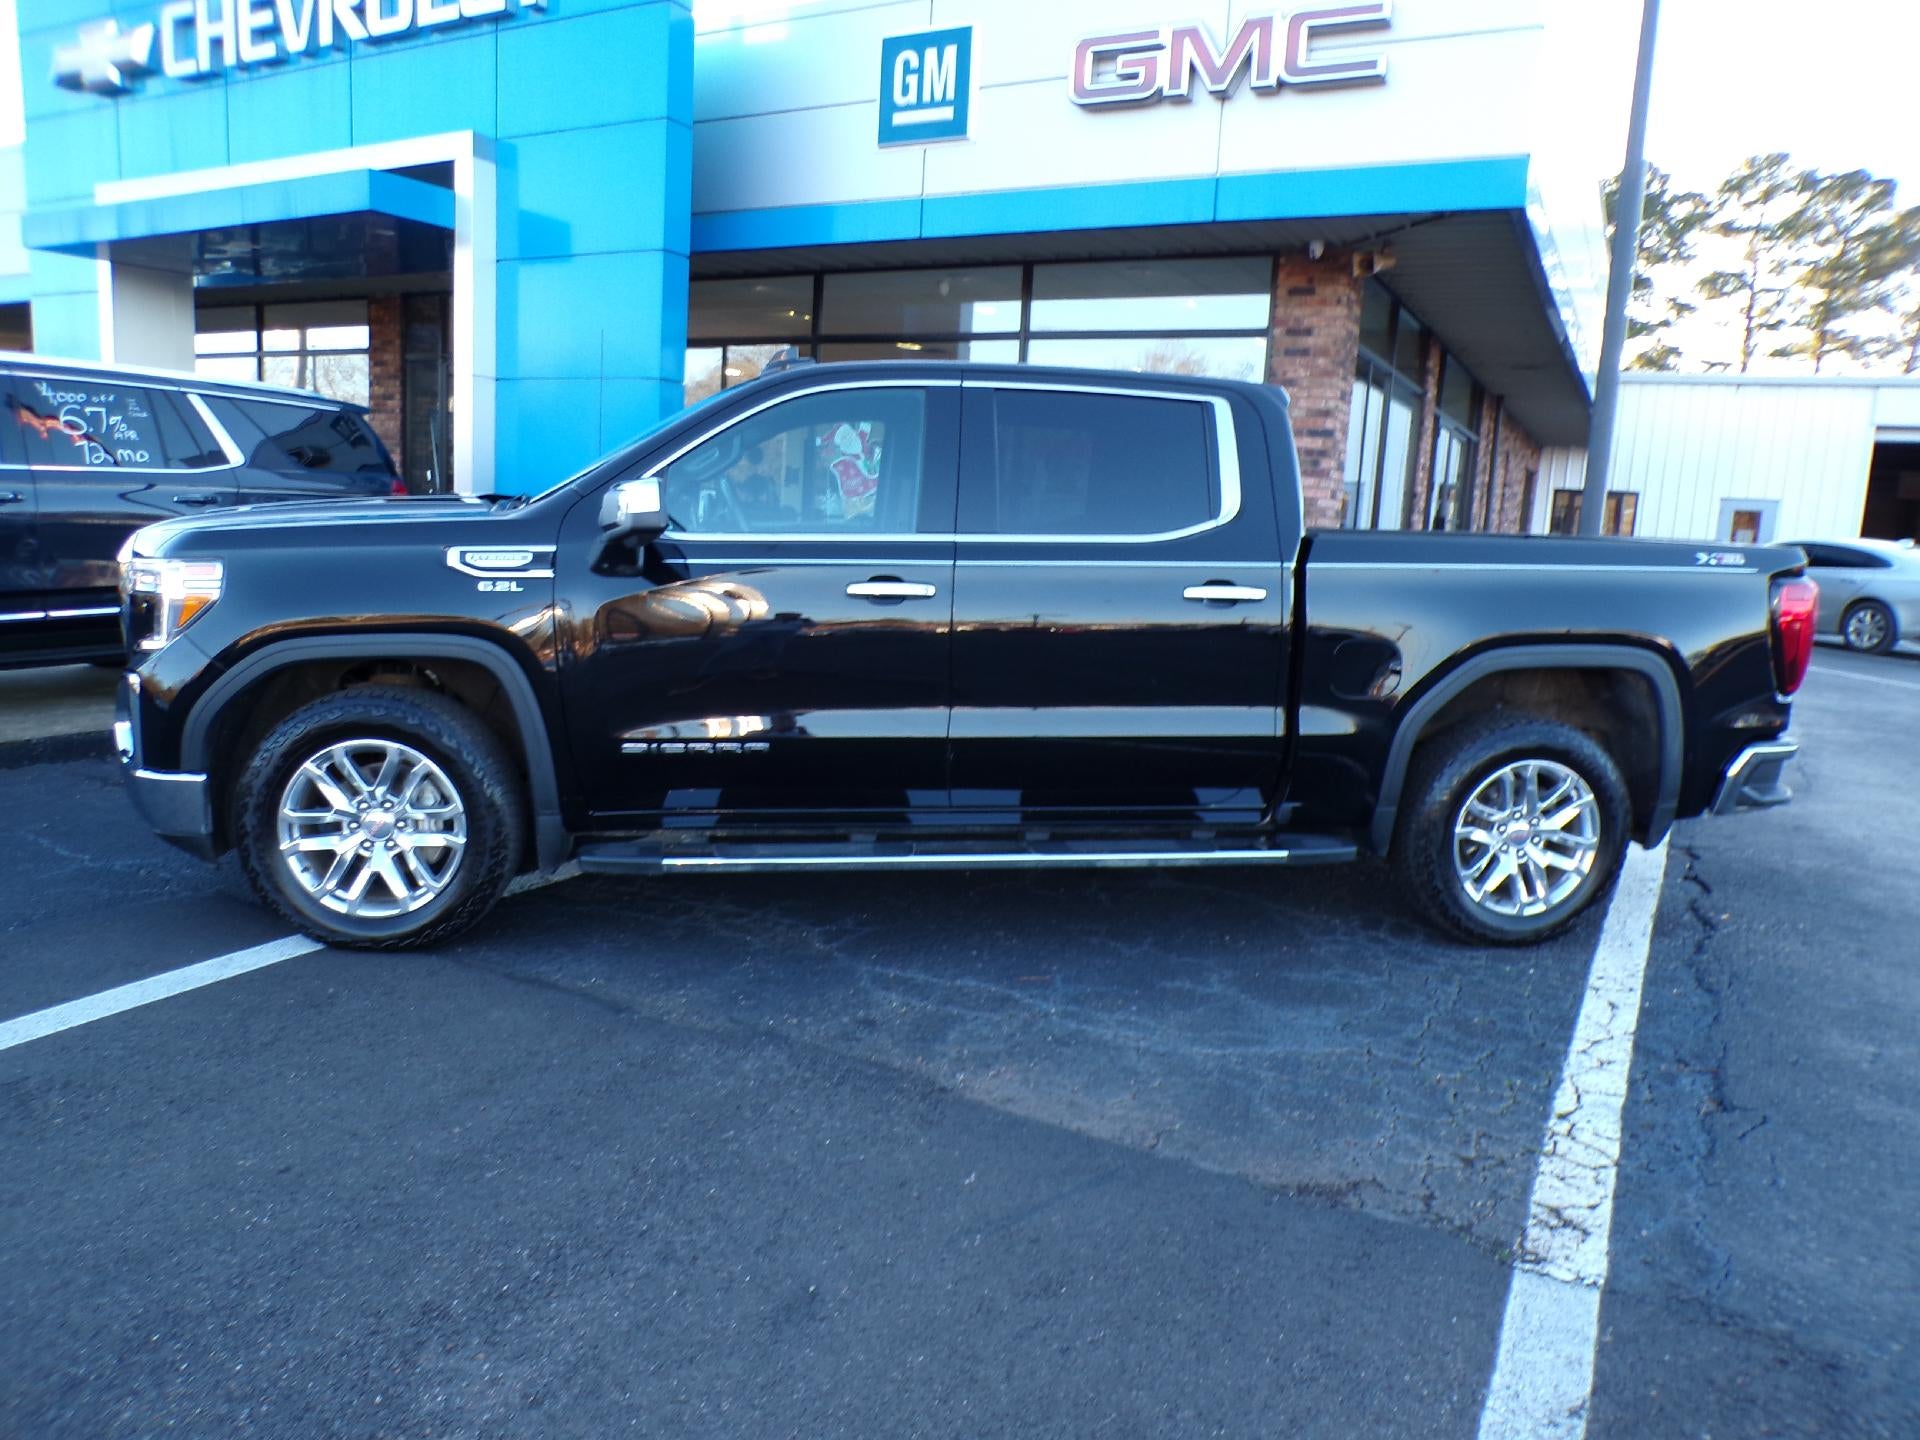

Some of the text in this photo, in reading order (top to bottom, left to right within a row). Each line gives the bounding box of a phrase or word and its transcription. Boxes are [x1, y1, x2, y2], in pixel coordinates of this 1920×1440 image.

[892, 44, 958, 105] GM
[1069, 0, 1392, 107] GMC
[73, 440, 115, 465] 72
